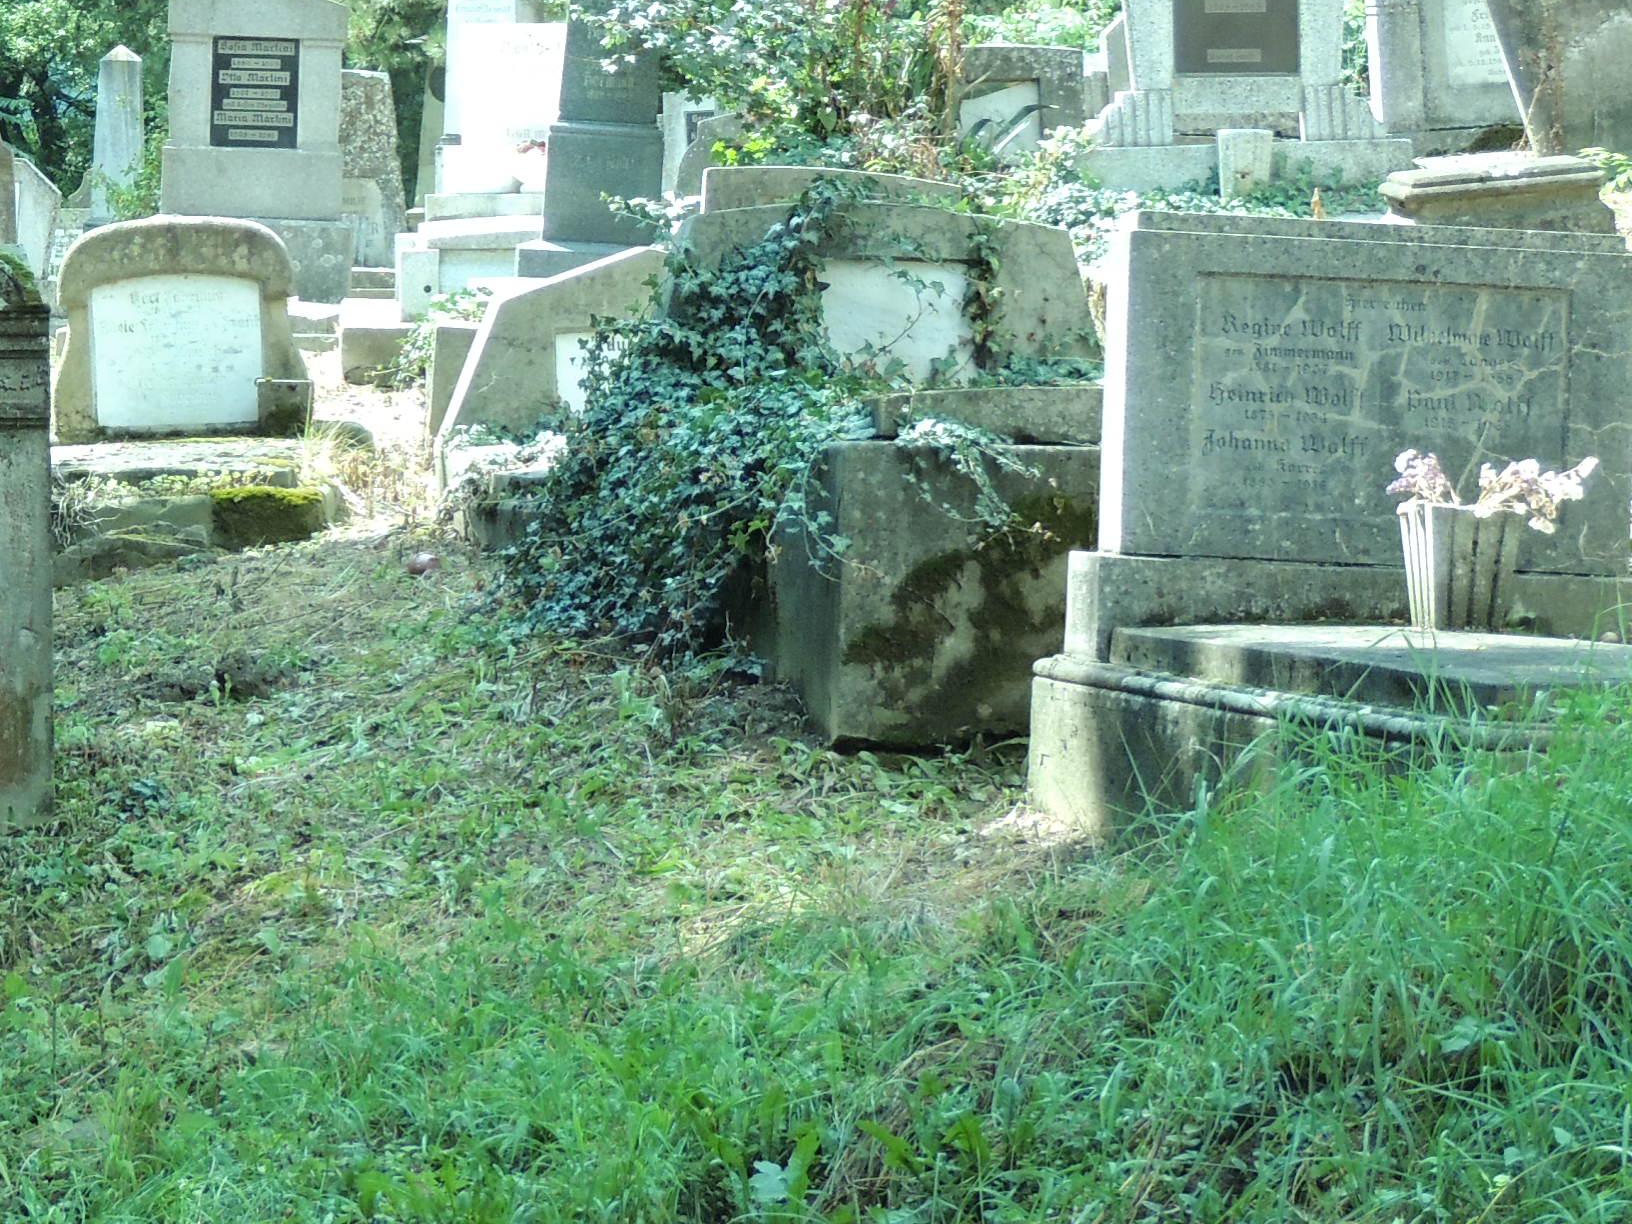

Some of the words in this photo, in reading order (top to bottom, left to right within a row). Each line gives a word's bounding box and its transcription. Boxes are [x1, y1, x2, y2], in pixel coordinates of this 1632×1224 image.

[1221, 311, 1290, 338] Regine
[1300, 319, 1362, 342] Wolff
[1253, 342, 1355, 361] Zimmermann
[1209, 382, 1294, 406] Heinrich
[1407, 389, 1457, 412] Paul
[1202, 428, 1290, 457] Johanna
[1300, 431, 1368, 457] Wolff
